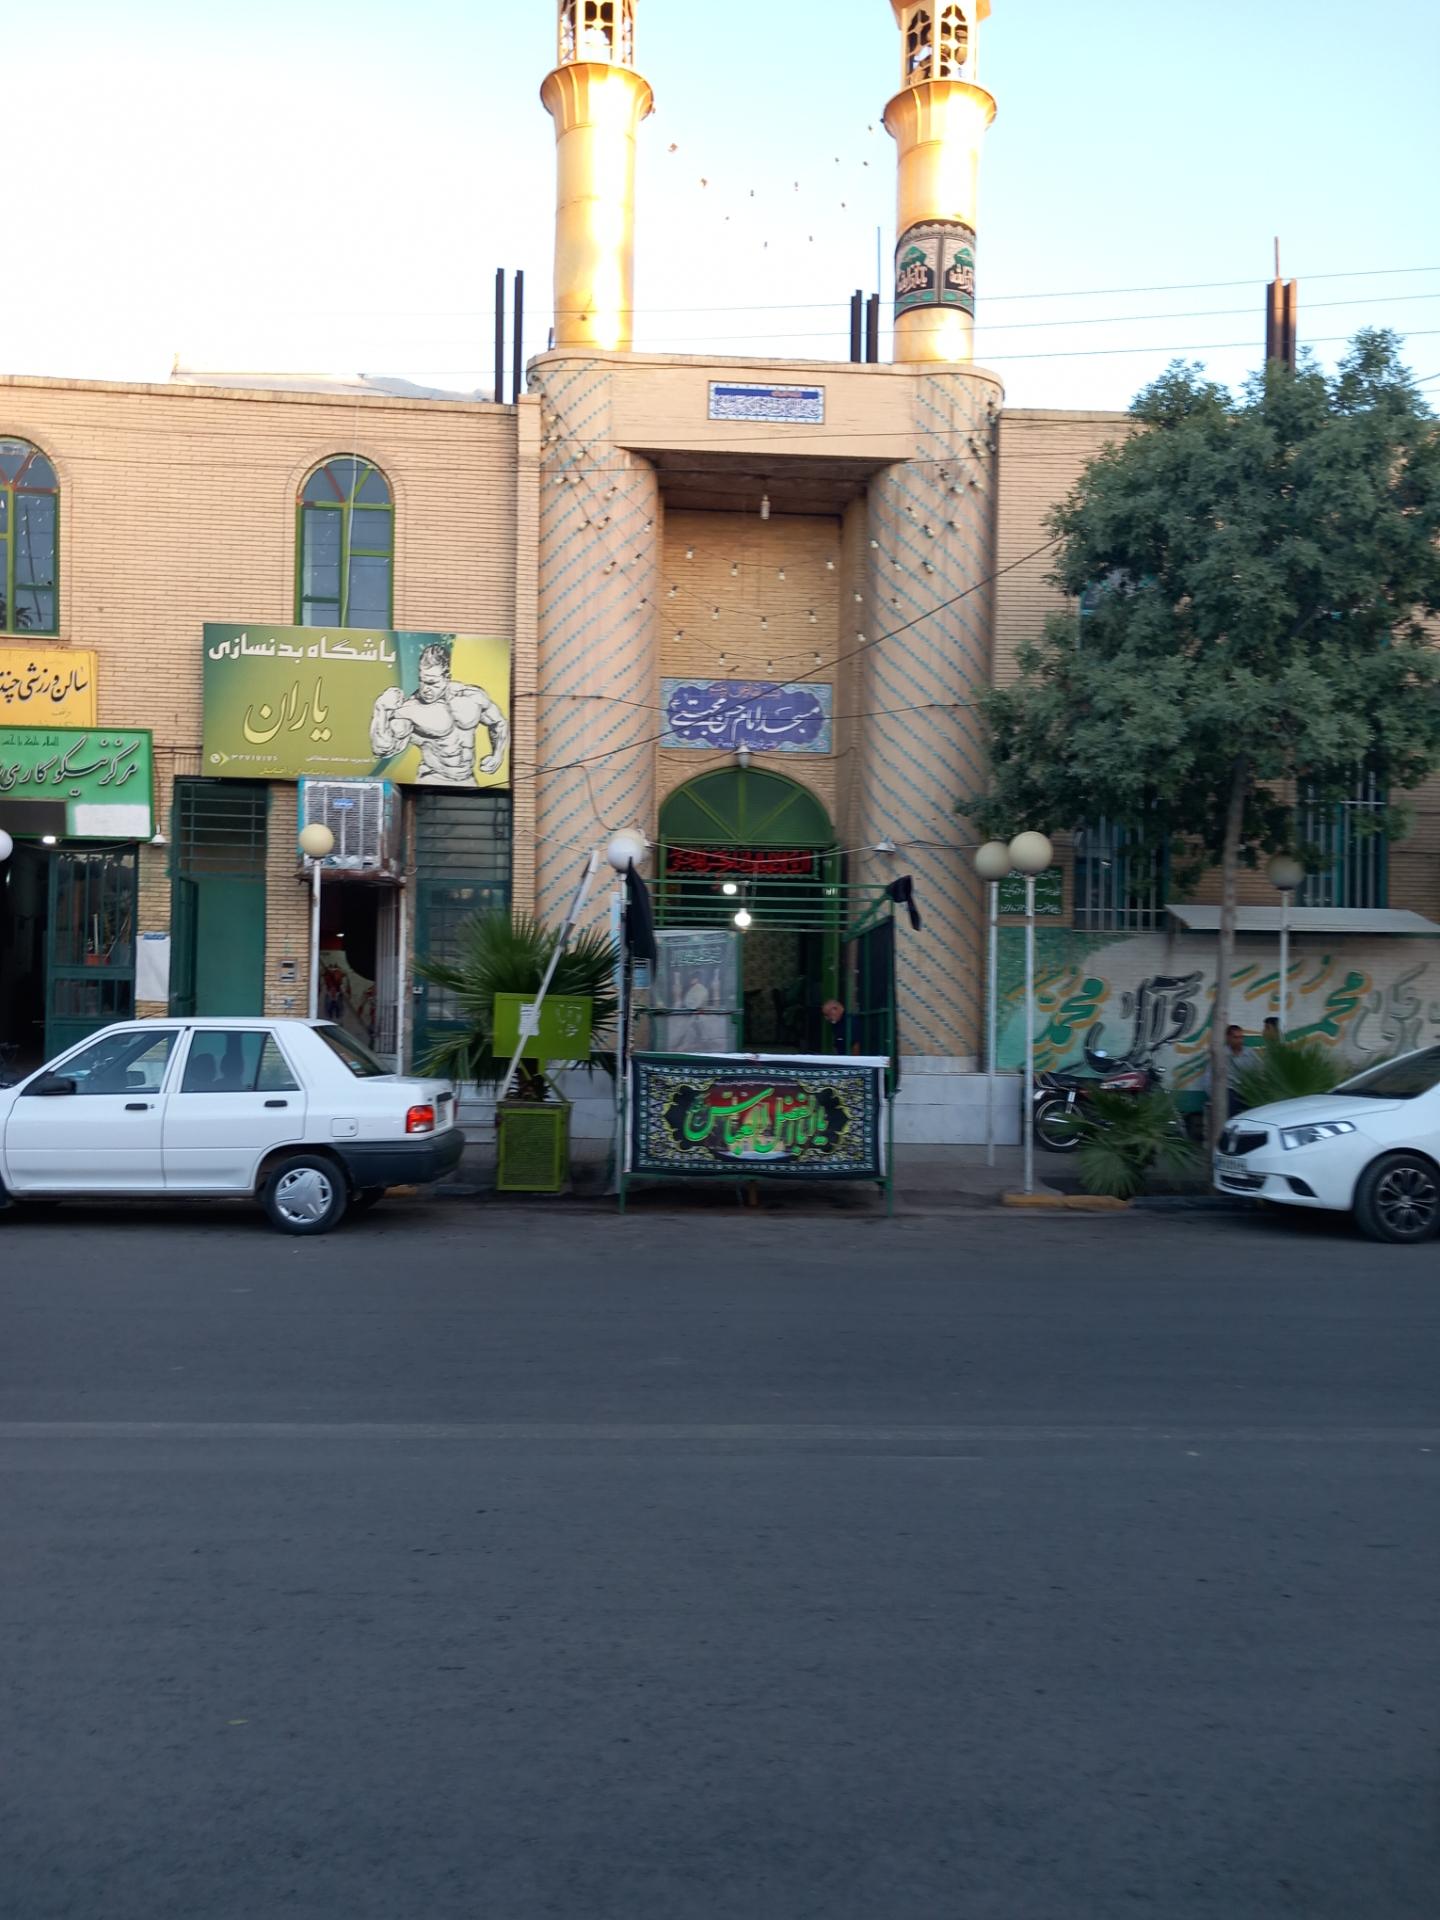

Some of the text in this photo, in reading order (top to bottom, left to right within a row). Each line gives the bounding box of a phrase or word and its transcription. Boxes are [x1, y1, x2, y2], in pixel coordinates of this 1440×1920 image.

[208, 632, 396, 668] باشگاه بدنسازی
[17, 662, 60, 701] ورزشی
[51, 669, 88, 702] سالن
[243, 676, 332, 745] یاران
[731, 705, 763, 742] امام
[755, 705, 820, 734] مسجد
[98, 737, 141, 786] مرکز
[1027, 976, 1113, 1054] محمد
[1084, 971, 1203, 1073] آل
[1174, 965, 1372, 1053] محمد
